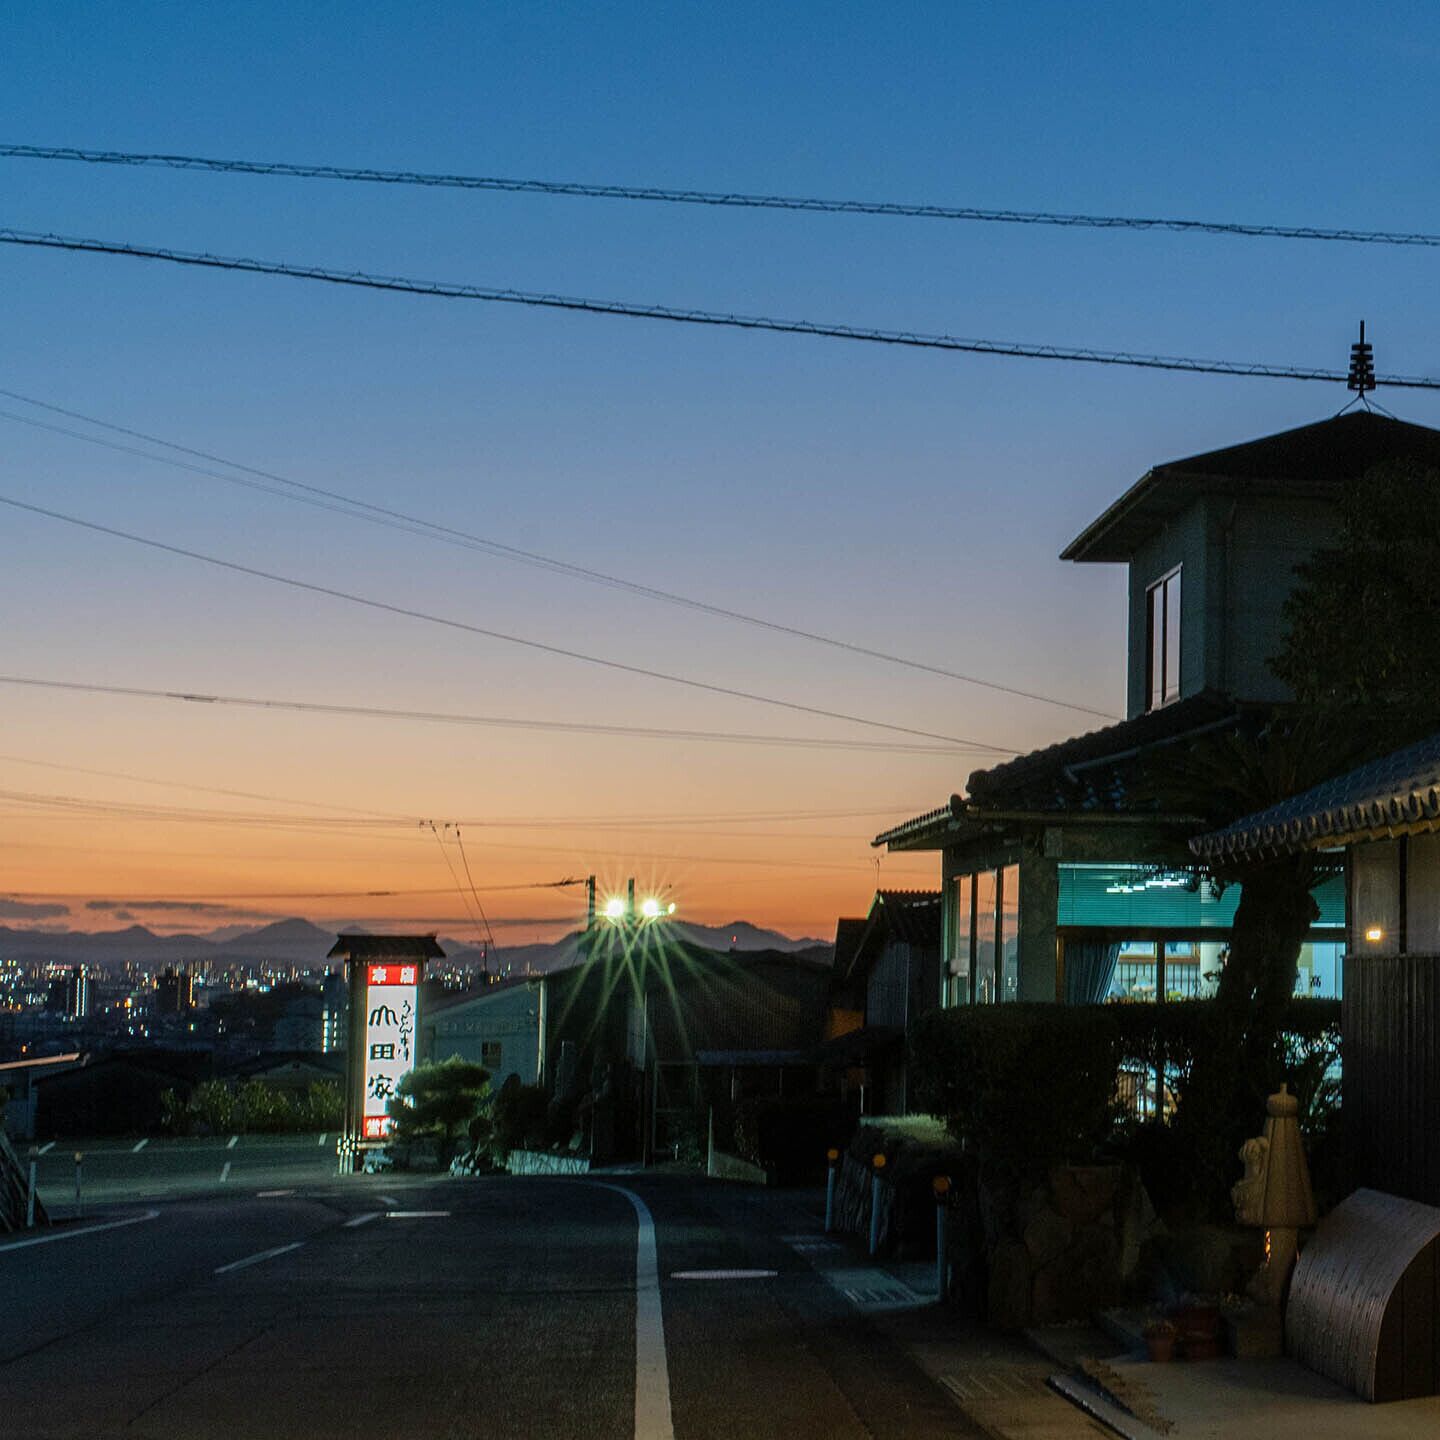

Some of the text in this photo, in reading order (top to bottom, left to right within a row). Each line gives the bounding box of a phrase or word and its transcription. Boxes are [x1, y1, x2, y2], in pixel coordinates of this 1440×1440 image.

[372, 966, 415, 984] 本店
[368, 1004, 399, 1099] 山田家
